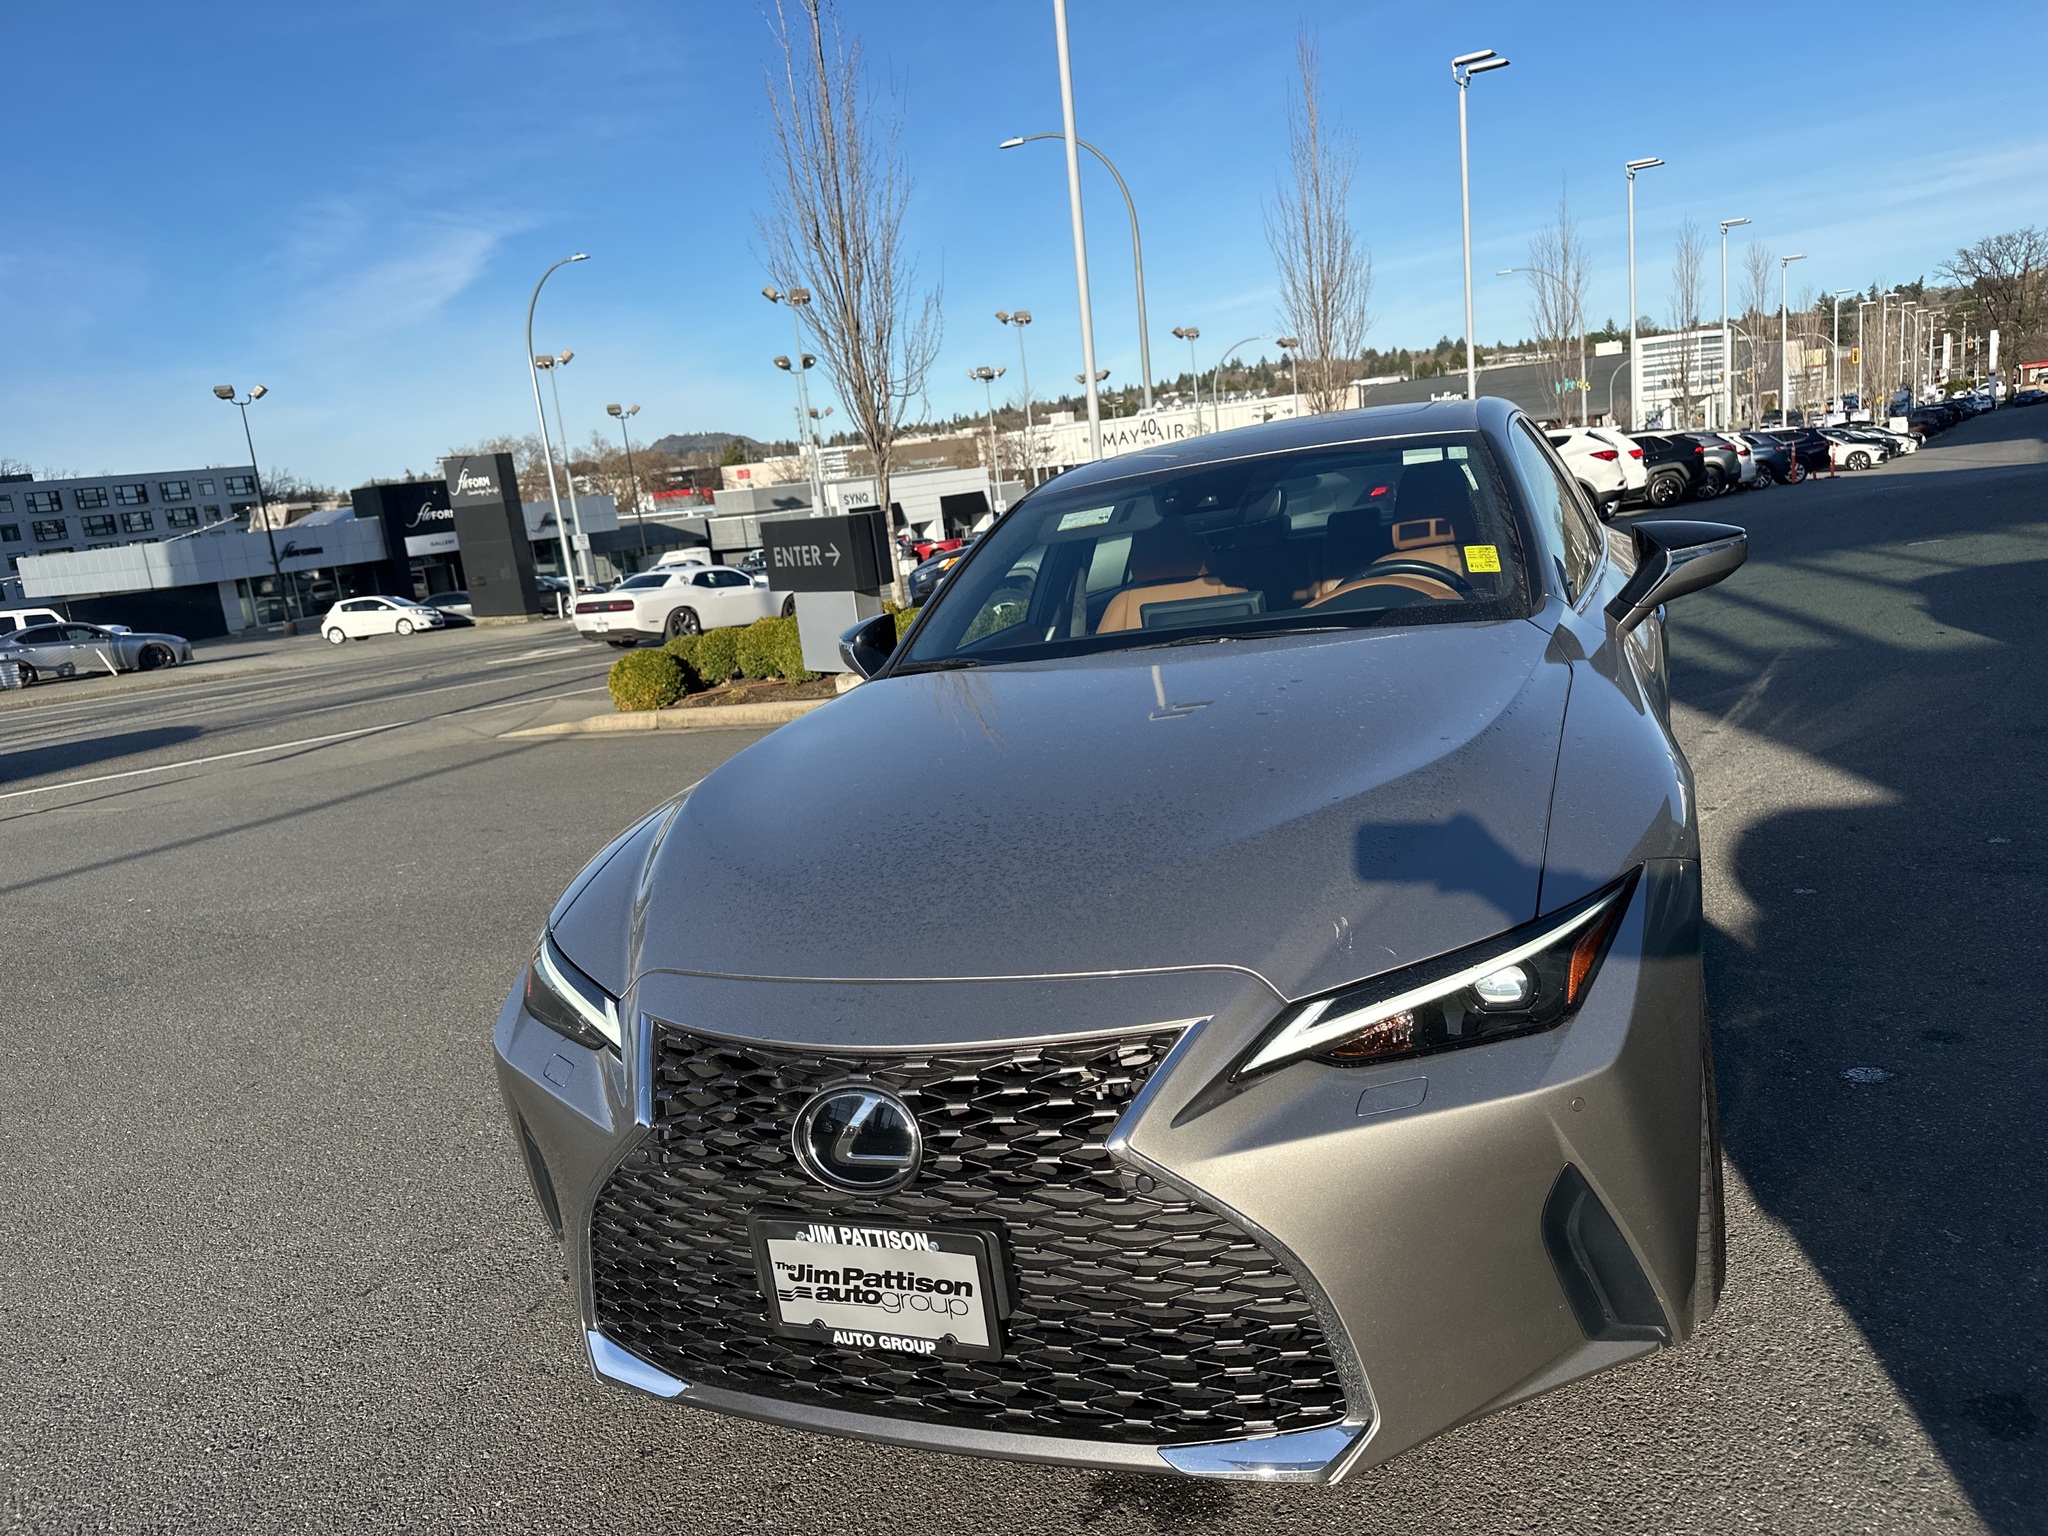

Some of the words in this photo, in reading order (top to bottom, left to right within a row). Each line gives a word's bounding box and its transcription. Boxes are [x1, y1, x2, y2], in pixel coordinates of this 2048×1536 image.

[1103, 423, 1185, 448] MAYAIR
[1141, 418, 1157, 437] 40
[843, 492, 869, 506] SYNQ
[773, 544, 823, 568] ENTER
[806, 1224, 837, 1245] JIM
[840, 1227, 929, 1252] PATTISON
[775, 1261, 796, 1272] The
[788, 1264, 840, 1285] Jim
[842, 1267, 973, 1298] Pattison
[832, 1330, 875, 1348] AUTO
[879, 1335, 936, 1355] GROUP
